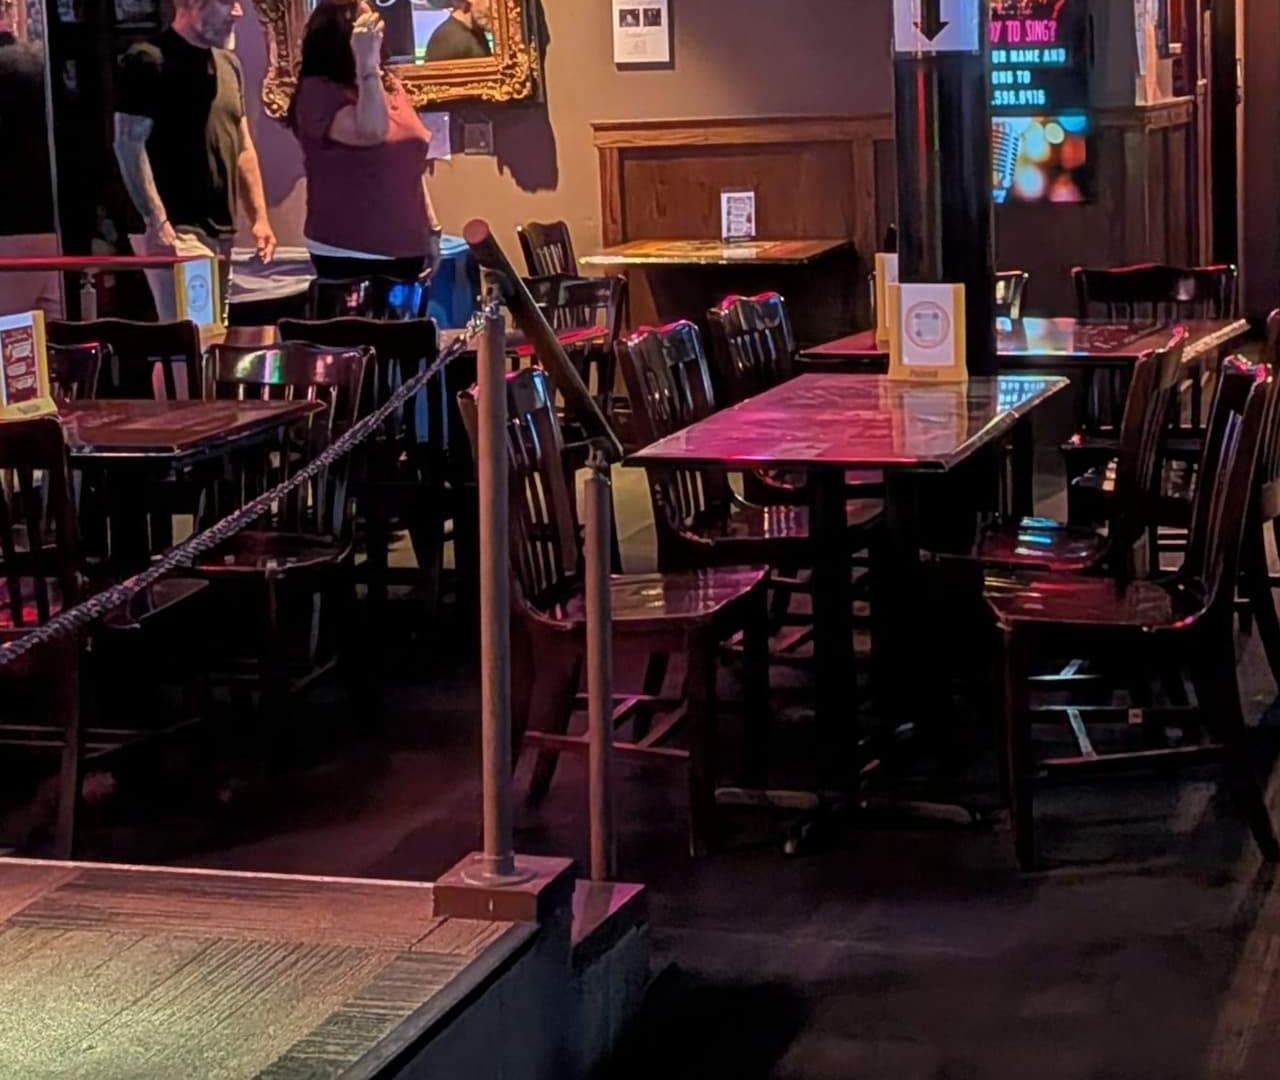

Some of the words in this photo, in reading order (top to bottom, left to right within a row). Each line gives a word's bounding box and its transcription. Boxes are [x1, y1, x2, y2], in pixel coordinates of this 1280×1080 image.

[1006, 21, 1021, 42] TO
[1025, 20, 1057, 42] SING?
[1010, 49, 1040, 63] NAME
[992, 70, 1014, 84] ONG
[1016, 70, 1031, 84] TO
